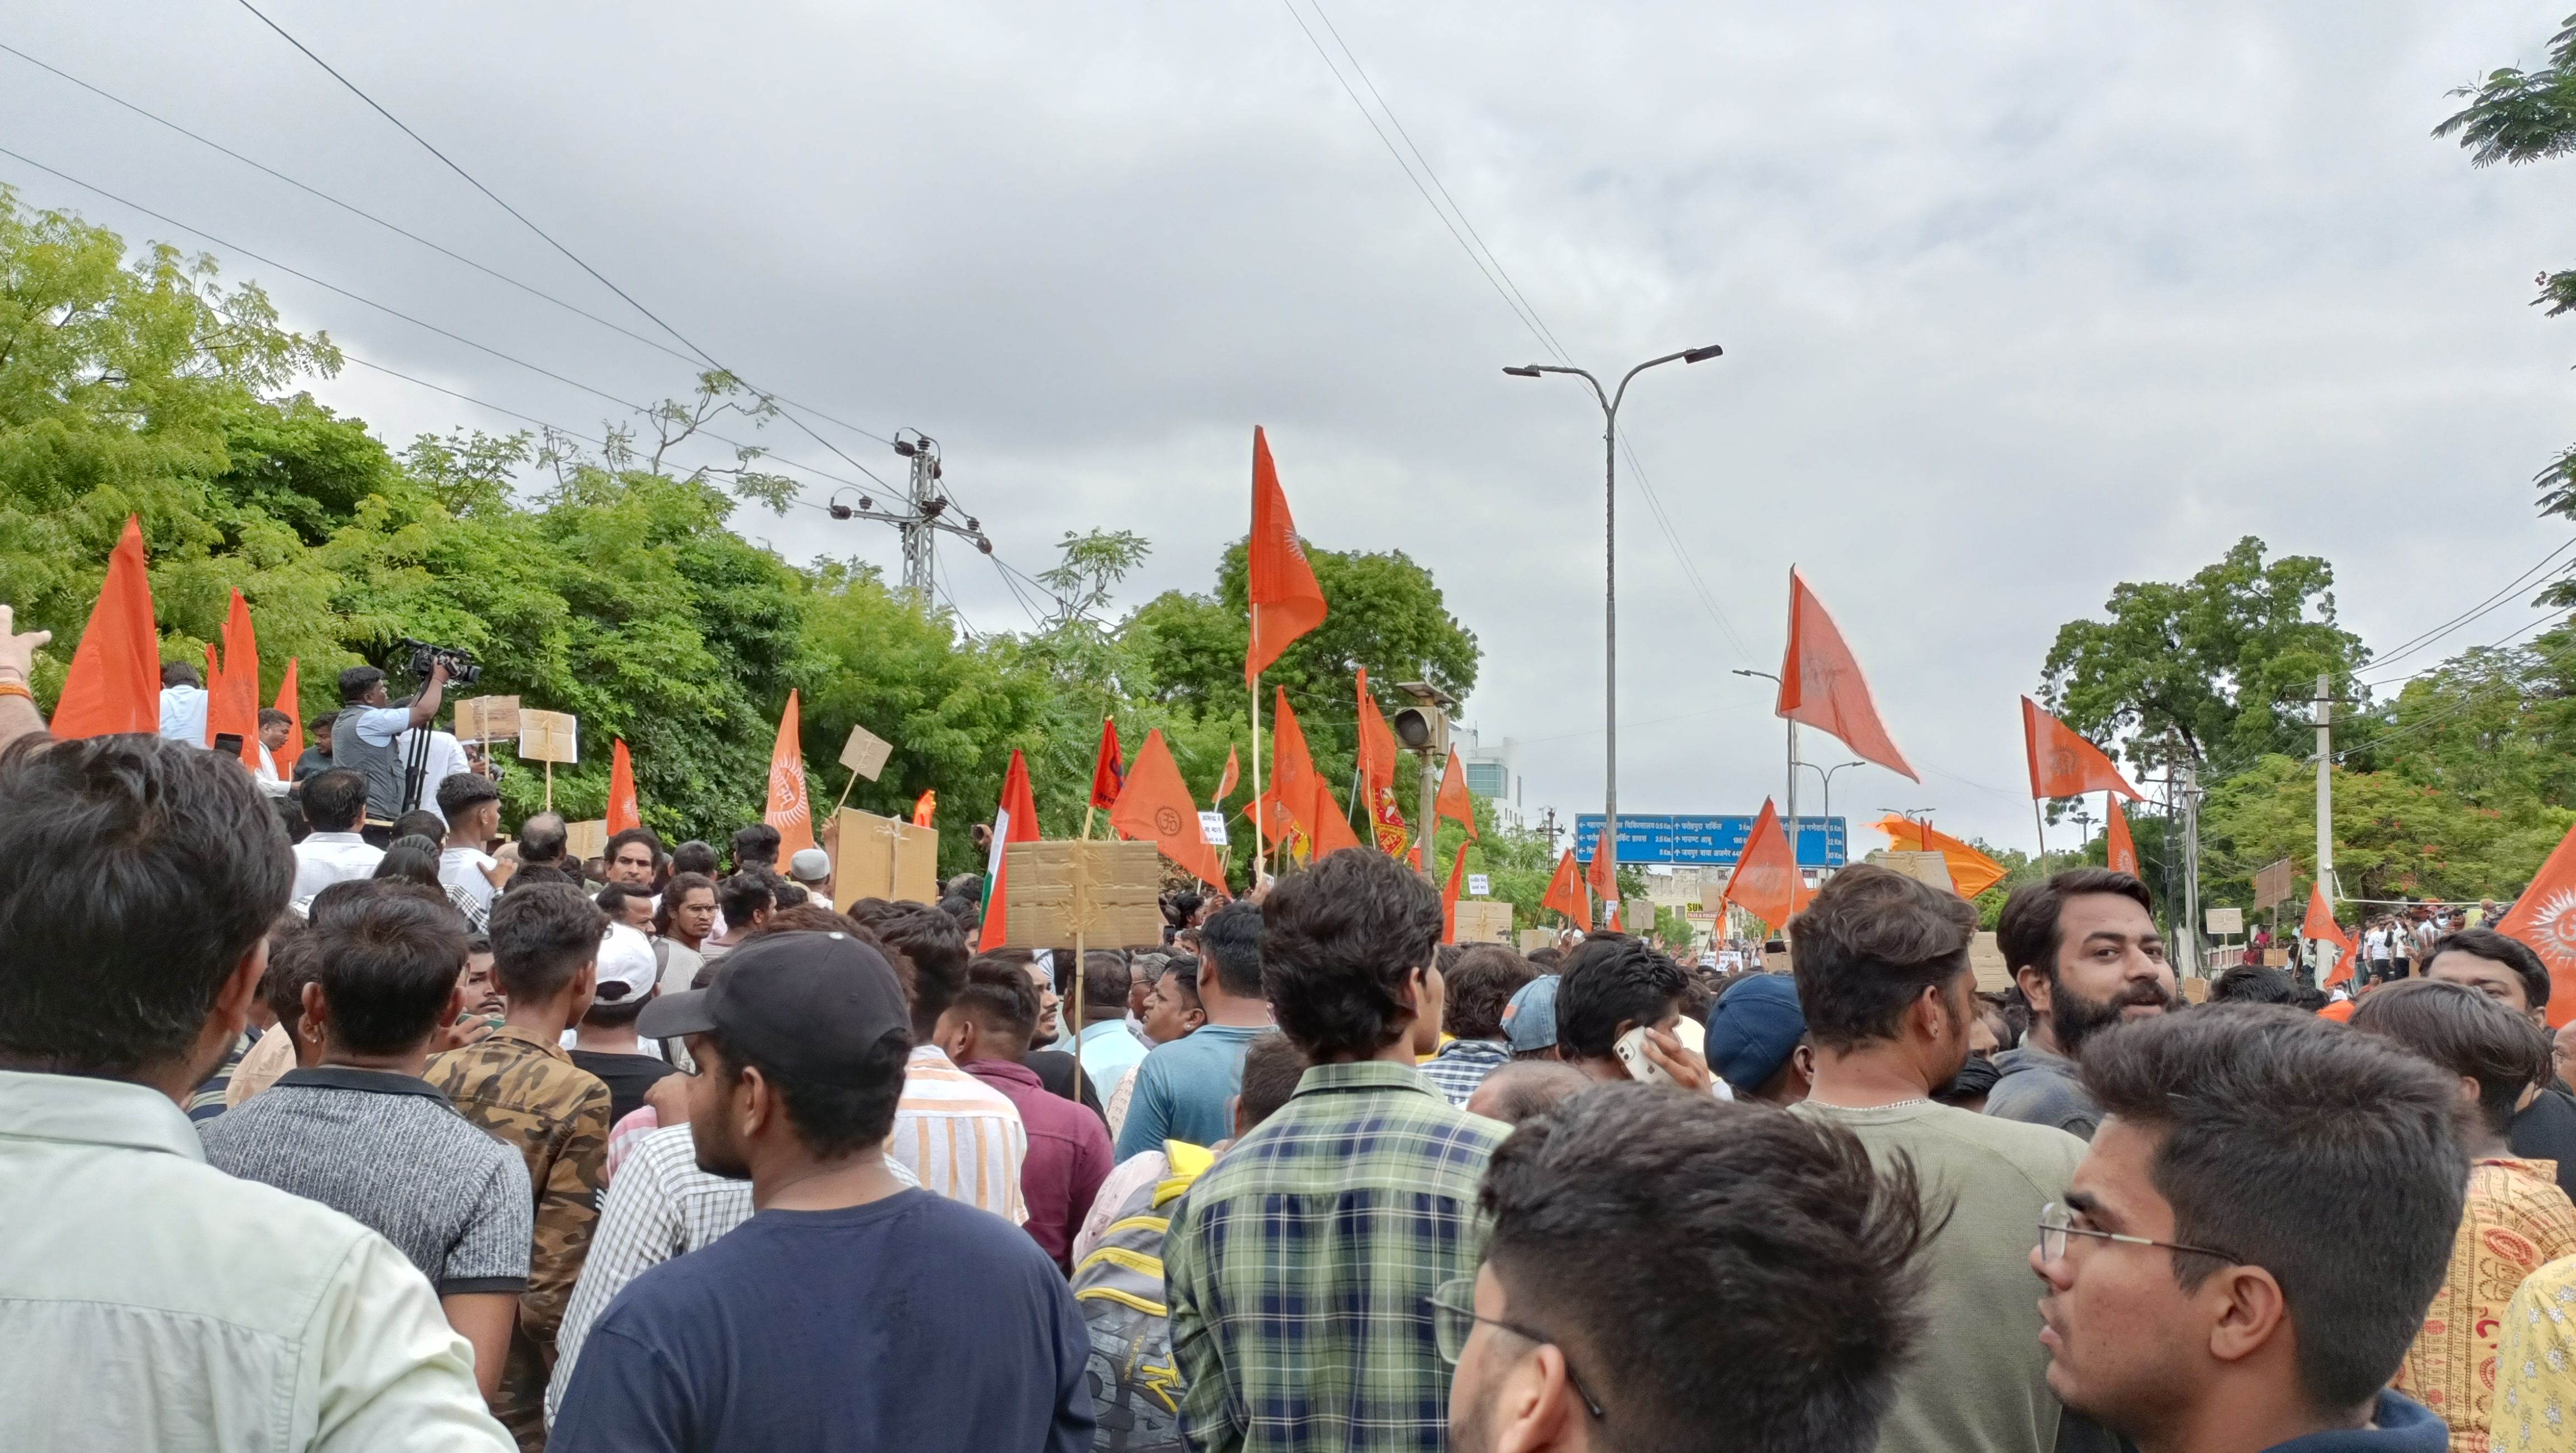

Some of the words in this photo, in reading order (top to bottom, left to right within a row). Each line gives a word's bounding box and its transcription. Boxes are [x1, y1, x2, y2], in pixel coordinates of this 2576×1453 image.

[1705, 821, 1722, 830] सर्किल
[1681, 849, 1698, 859] जयपुर
[1713, 848, 1731, 857] अजमेर
